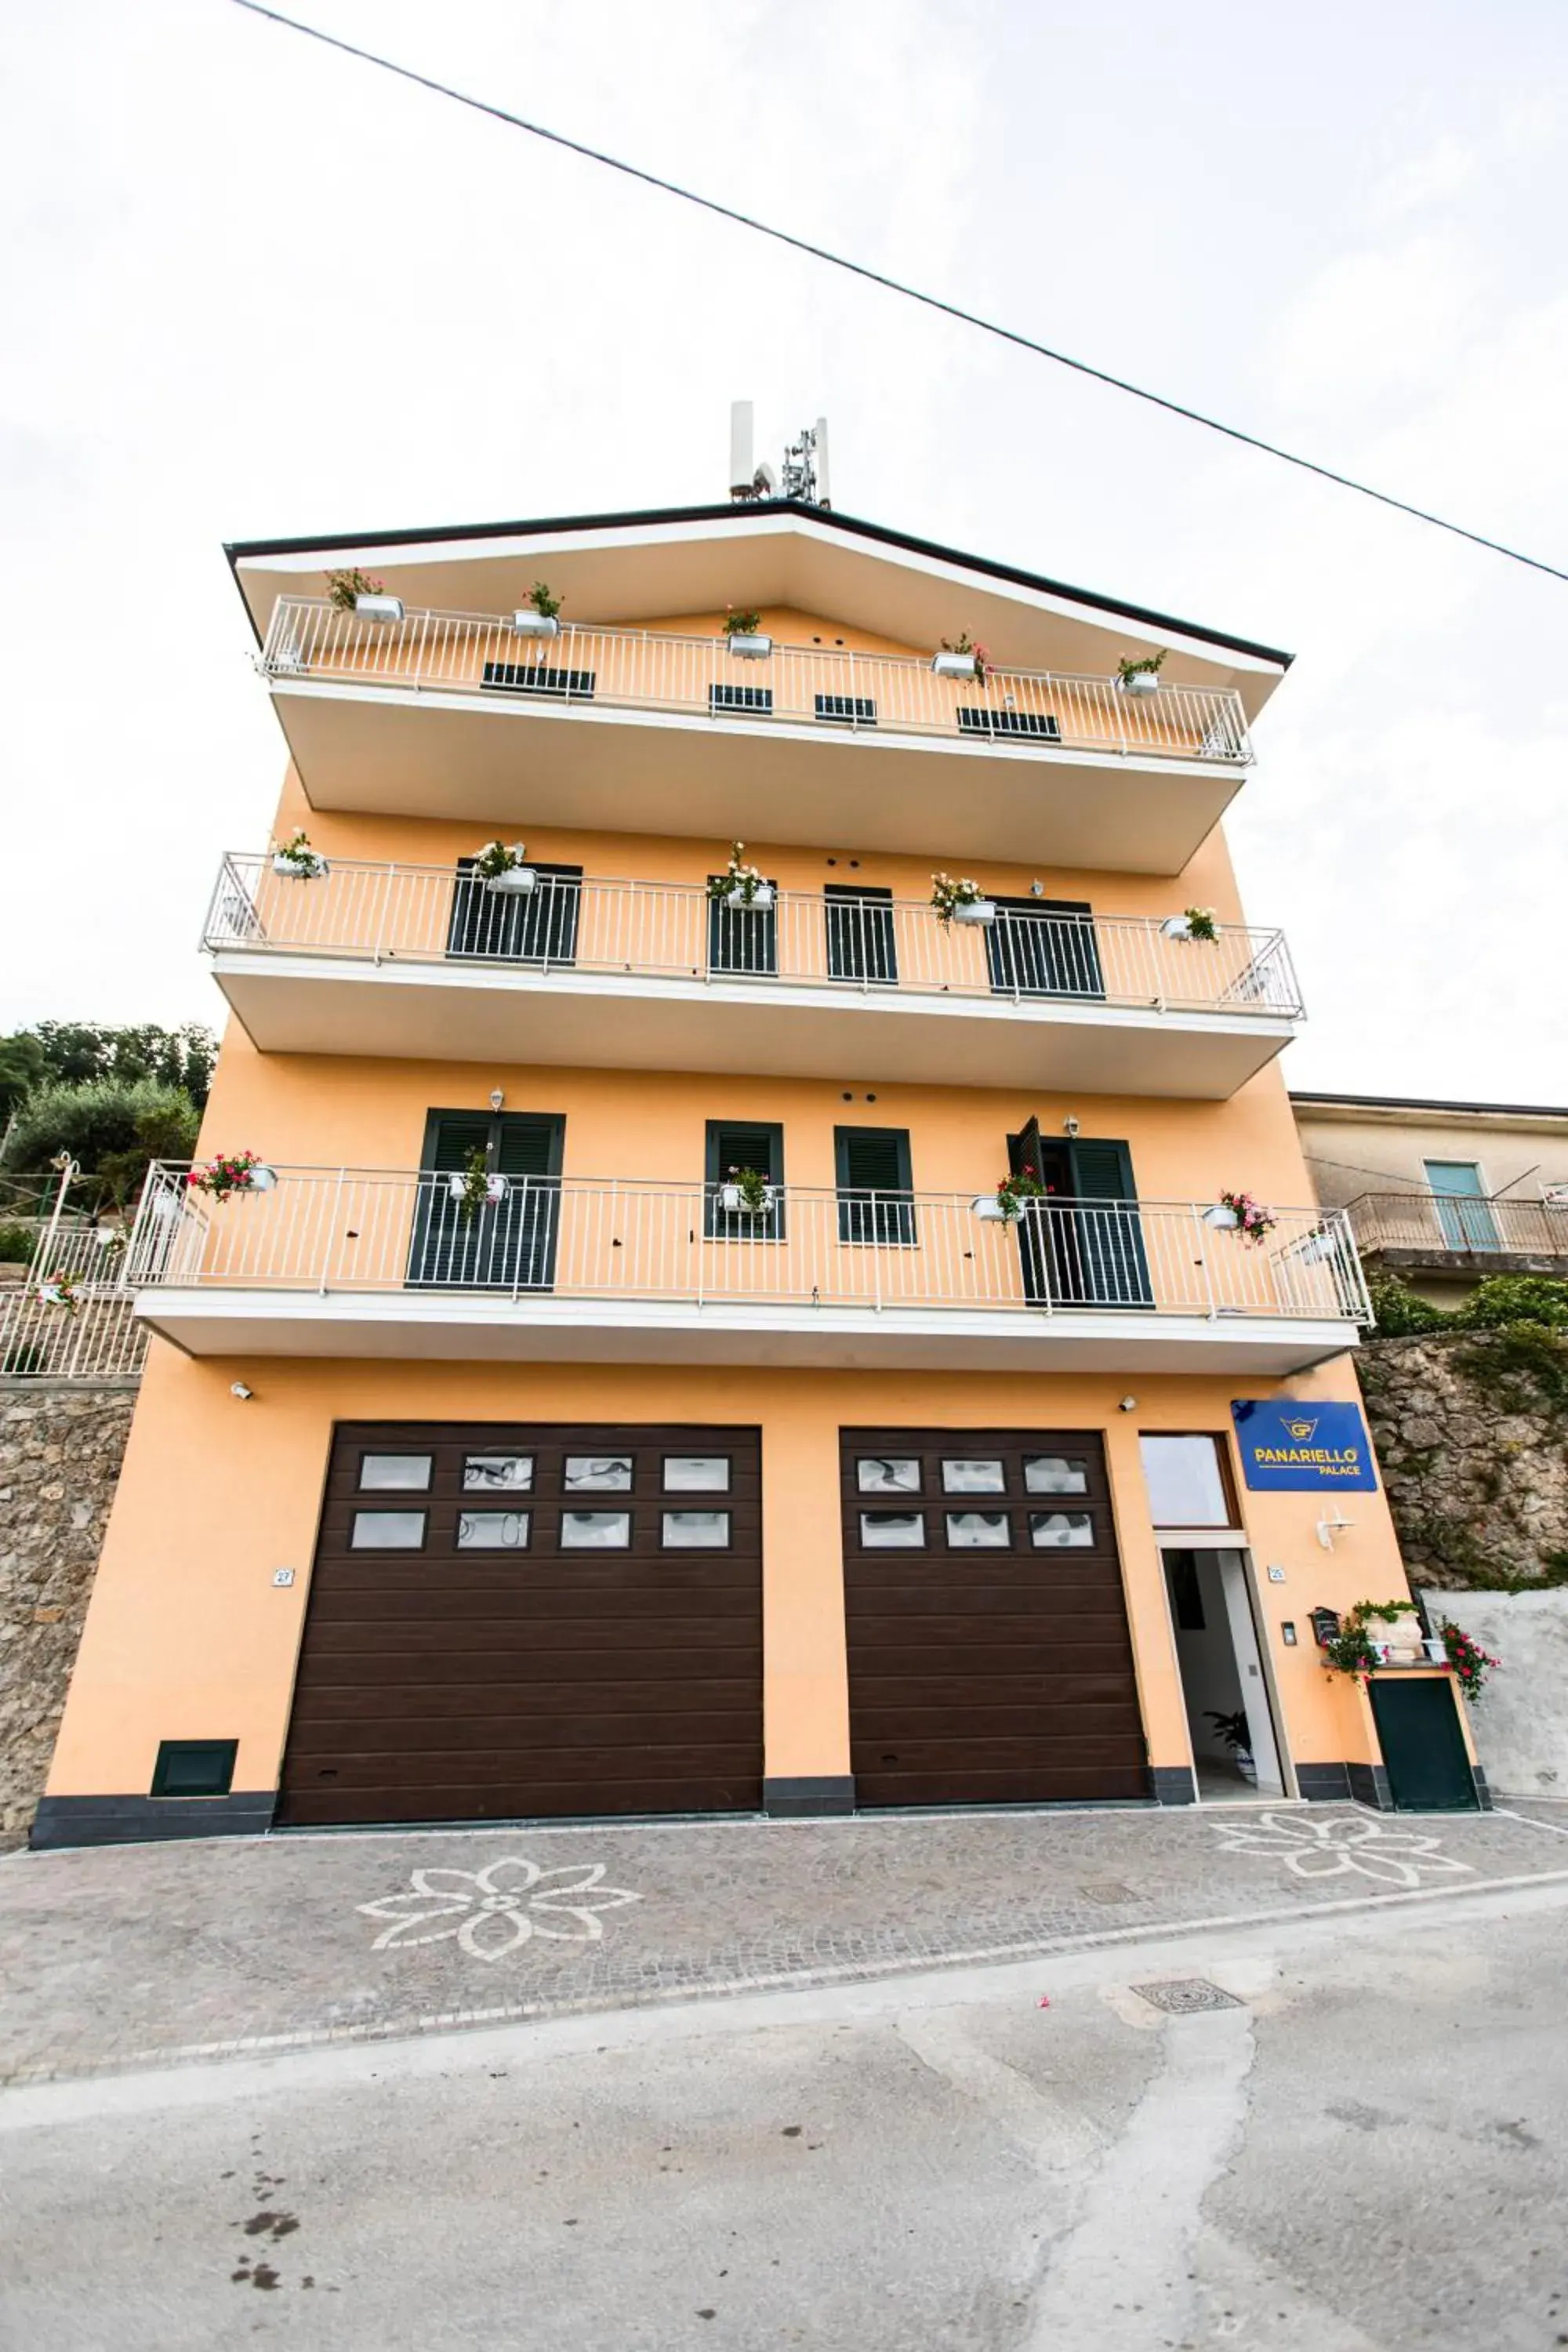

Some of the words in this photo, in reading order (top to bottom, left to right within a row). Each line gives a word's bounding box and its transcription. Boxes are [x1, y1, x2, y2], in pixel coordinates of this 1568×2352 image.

[1254, 1448, 1358, 1463] PANARIELLO
[1319, 1465, 1361, 1475] PALACE
[278, 1572, 289, 1582] 27
